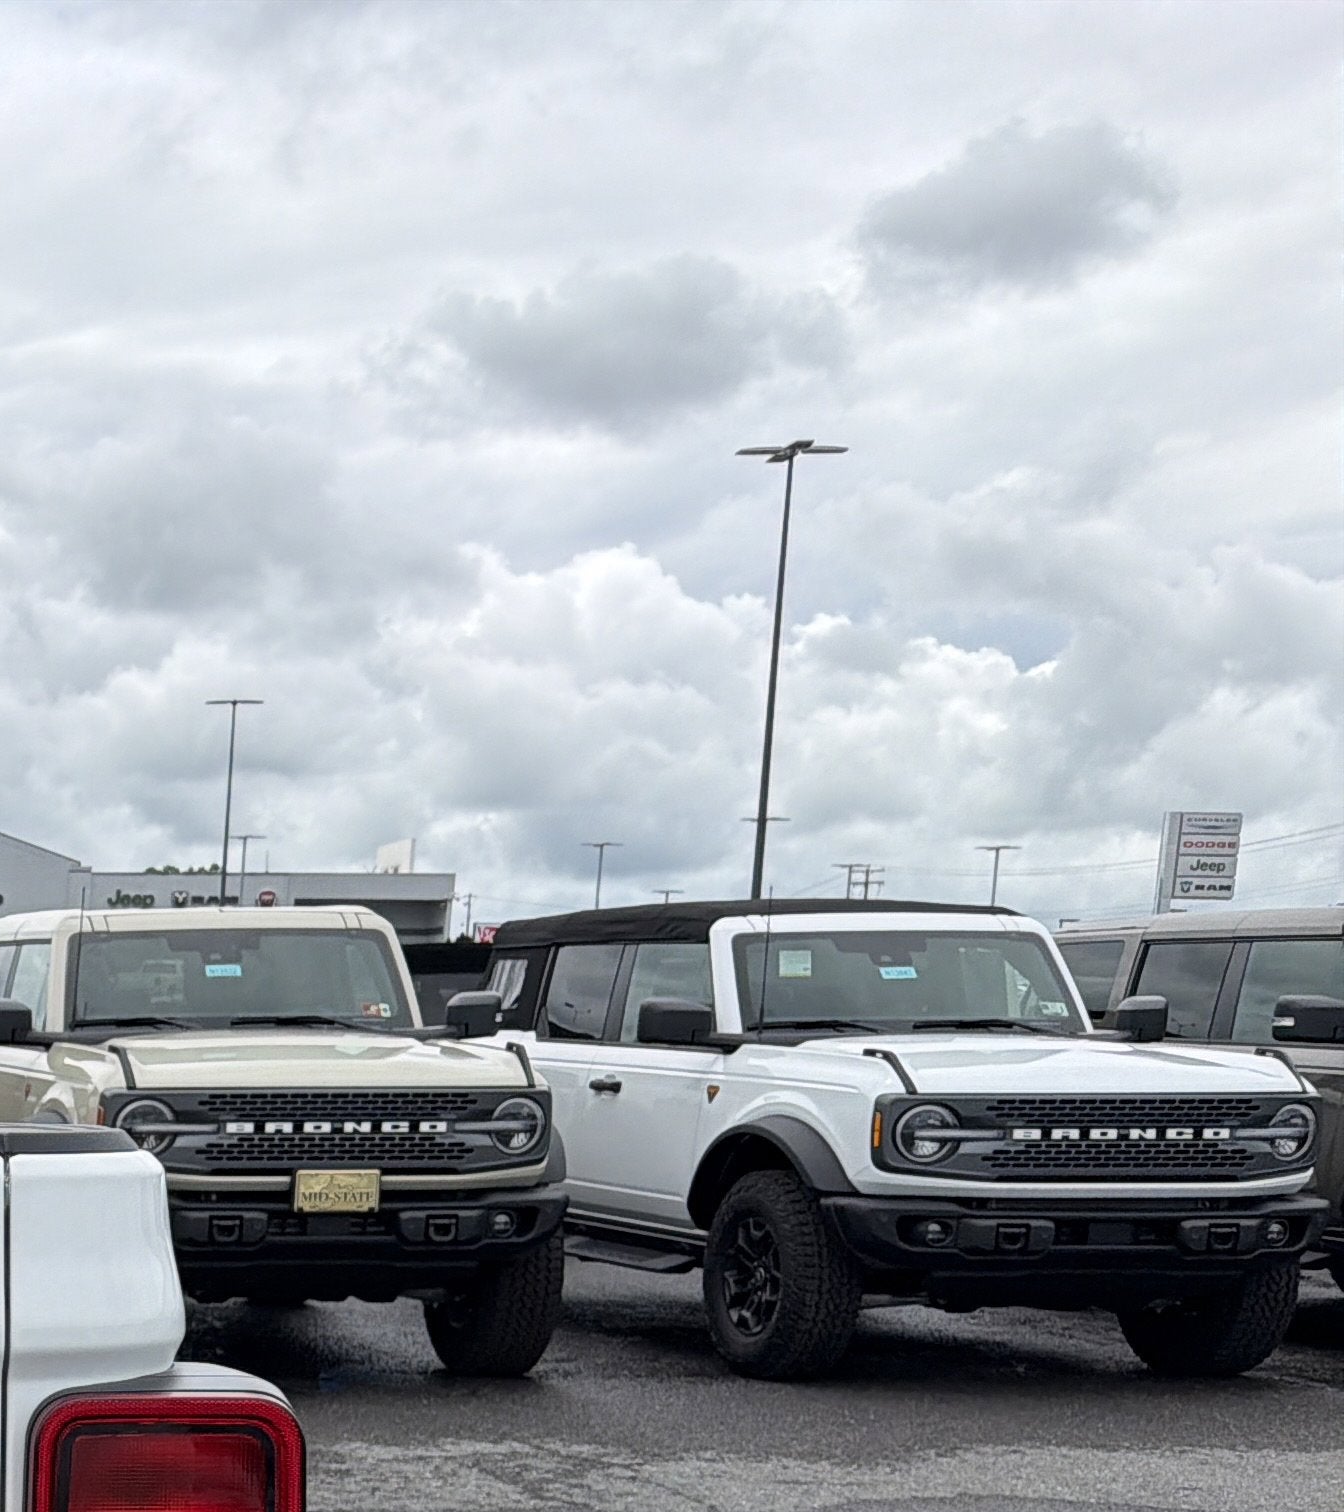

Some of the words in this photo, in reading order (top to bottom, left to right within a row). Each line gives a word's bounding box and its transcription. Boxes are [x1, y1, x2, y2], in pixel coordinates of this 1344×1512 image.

[1183, 841, 1237, 849] DODGE
[1189, 859, 1226, 874] Jeep
[1194, 884, 1232, 892] RAM
[107, 889, 156, 907] Jeep
[225, 1121, 448, 1134] BRONCO
[1012, 1127, 1231, 1140] BRONCO
[300, 1191, 374, 1203] MID-STATE
